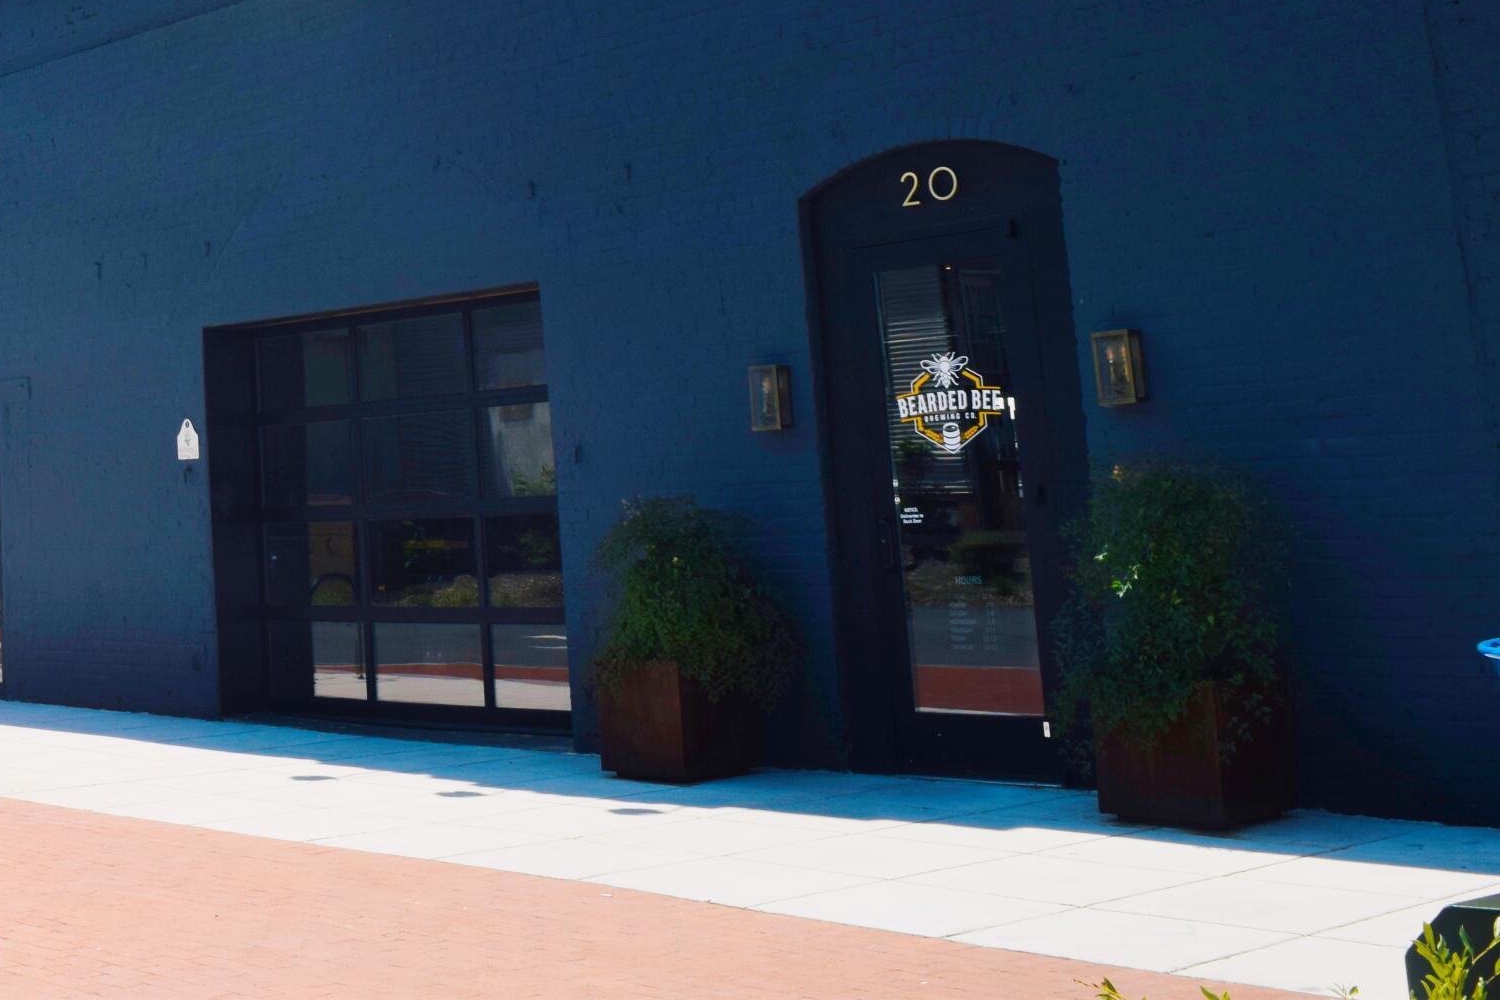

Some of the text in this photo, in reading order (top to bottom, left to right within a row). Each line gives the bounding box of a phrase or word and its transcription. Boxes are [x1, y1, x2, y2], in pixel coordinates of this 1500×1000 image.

[900, 166, 957, 207] 20
[897, 389, 1002, 419] BEARDED BEE
[924, 411, 977, 422] BREWING CO.
[954, 575, 982, 585] HOURS
